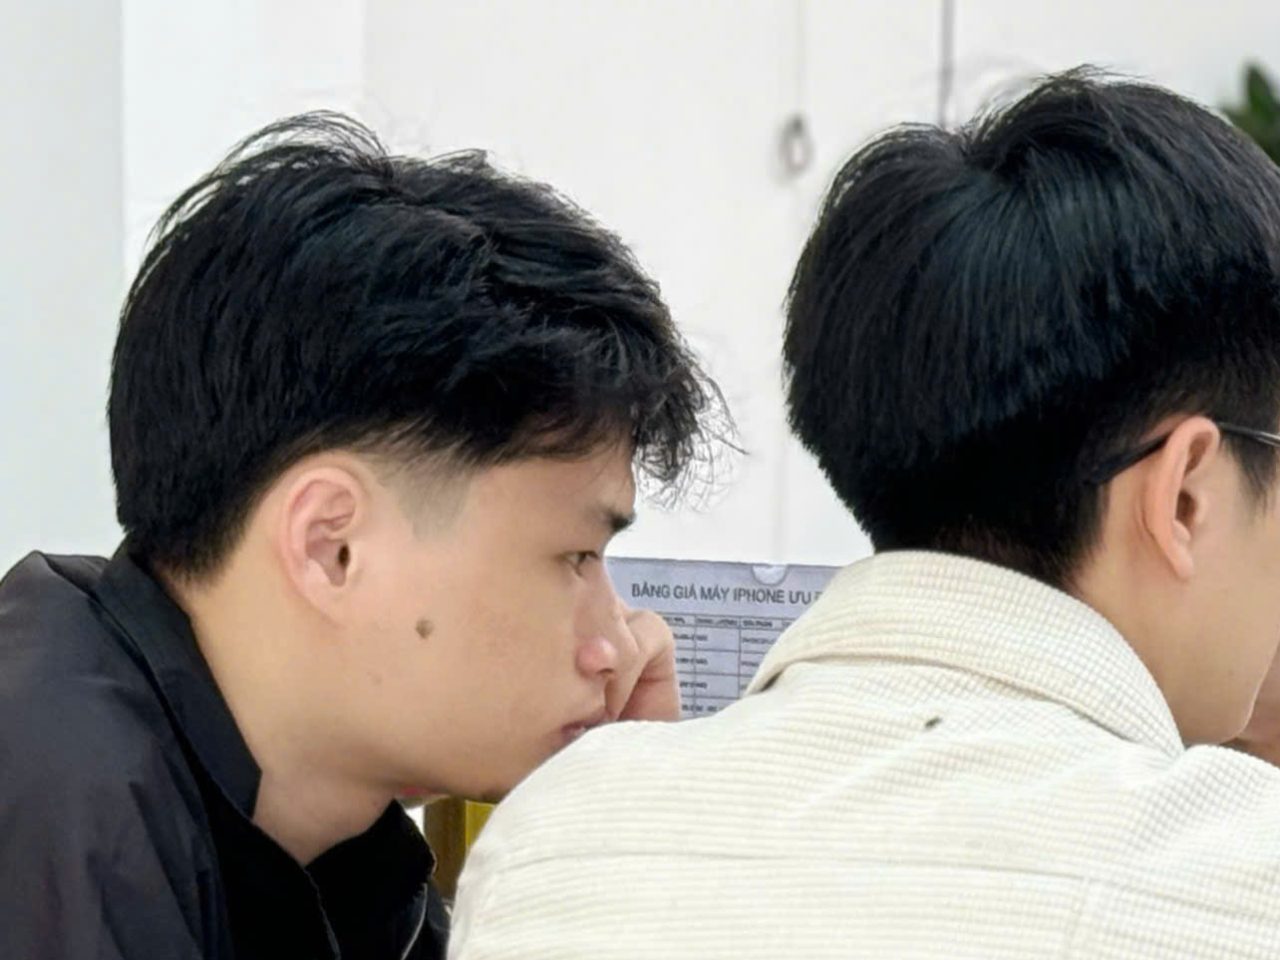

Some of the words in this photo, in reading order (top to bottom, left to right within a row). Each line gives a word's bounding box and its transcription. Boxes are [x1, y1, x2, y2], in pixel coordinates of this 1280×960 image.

[673, 583, 697, 600] GIÁ
[700, 586, 730, 602] MÁY
[733, 588, 786, 604] IPHONE
